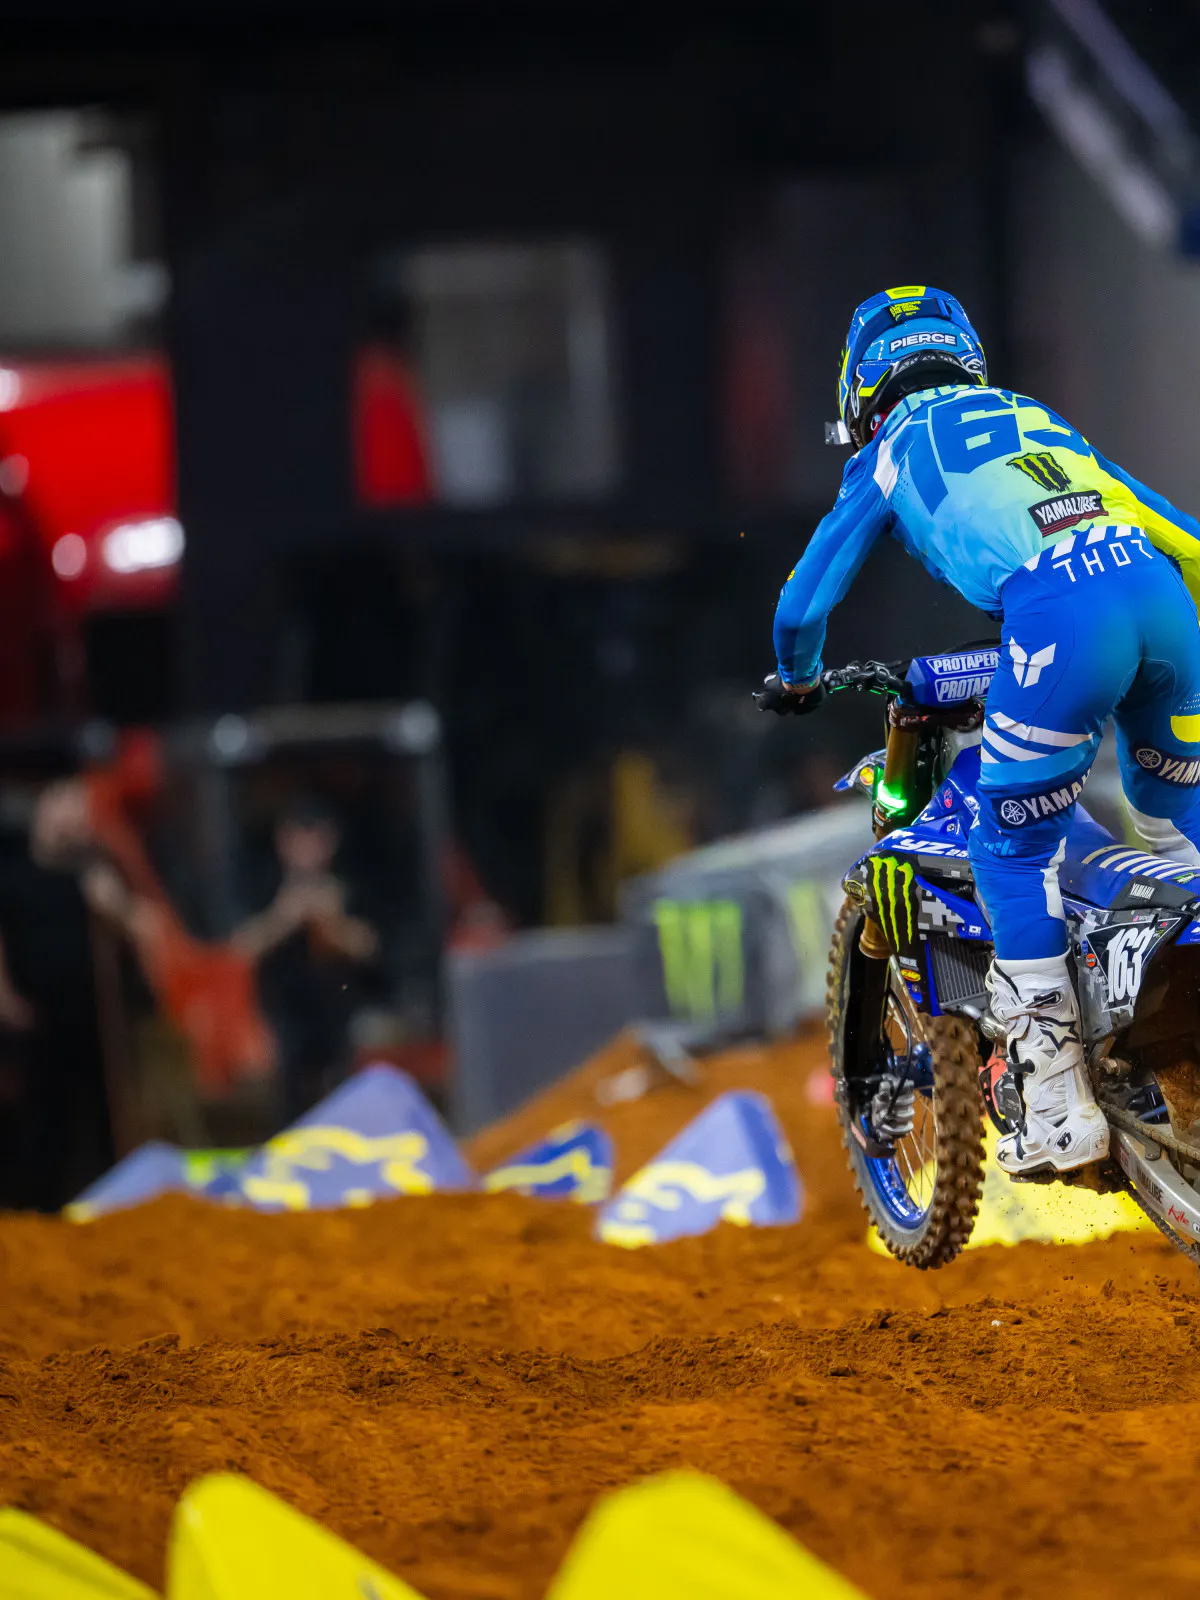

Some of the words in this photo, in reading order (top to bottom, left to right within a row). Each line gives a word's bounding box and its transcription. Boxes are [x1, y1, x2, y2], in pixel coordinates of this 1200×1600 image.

[890, 333, 957, 353] PIERCE
[1035, 495, 1100, 525] YAMALUBE
[933, 652, 998, 674] PROTAPER
[938, 676, 994, 702] PROTAP
[1022, 768, 1091, 818] YAMA
[1129, 883, 1155, 900] YAMAHA
[1106, 927, 1156, 1003] 163
